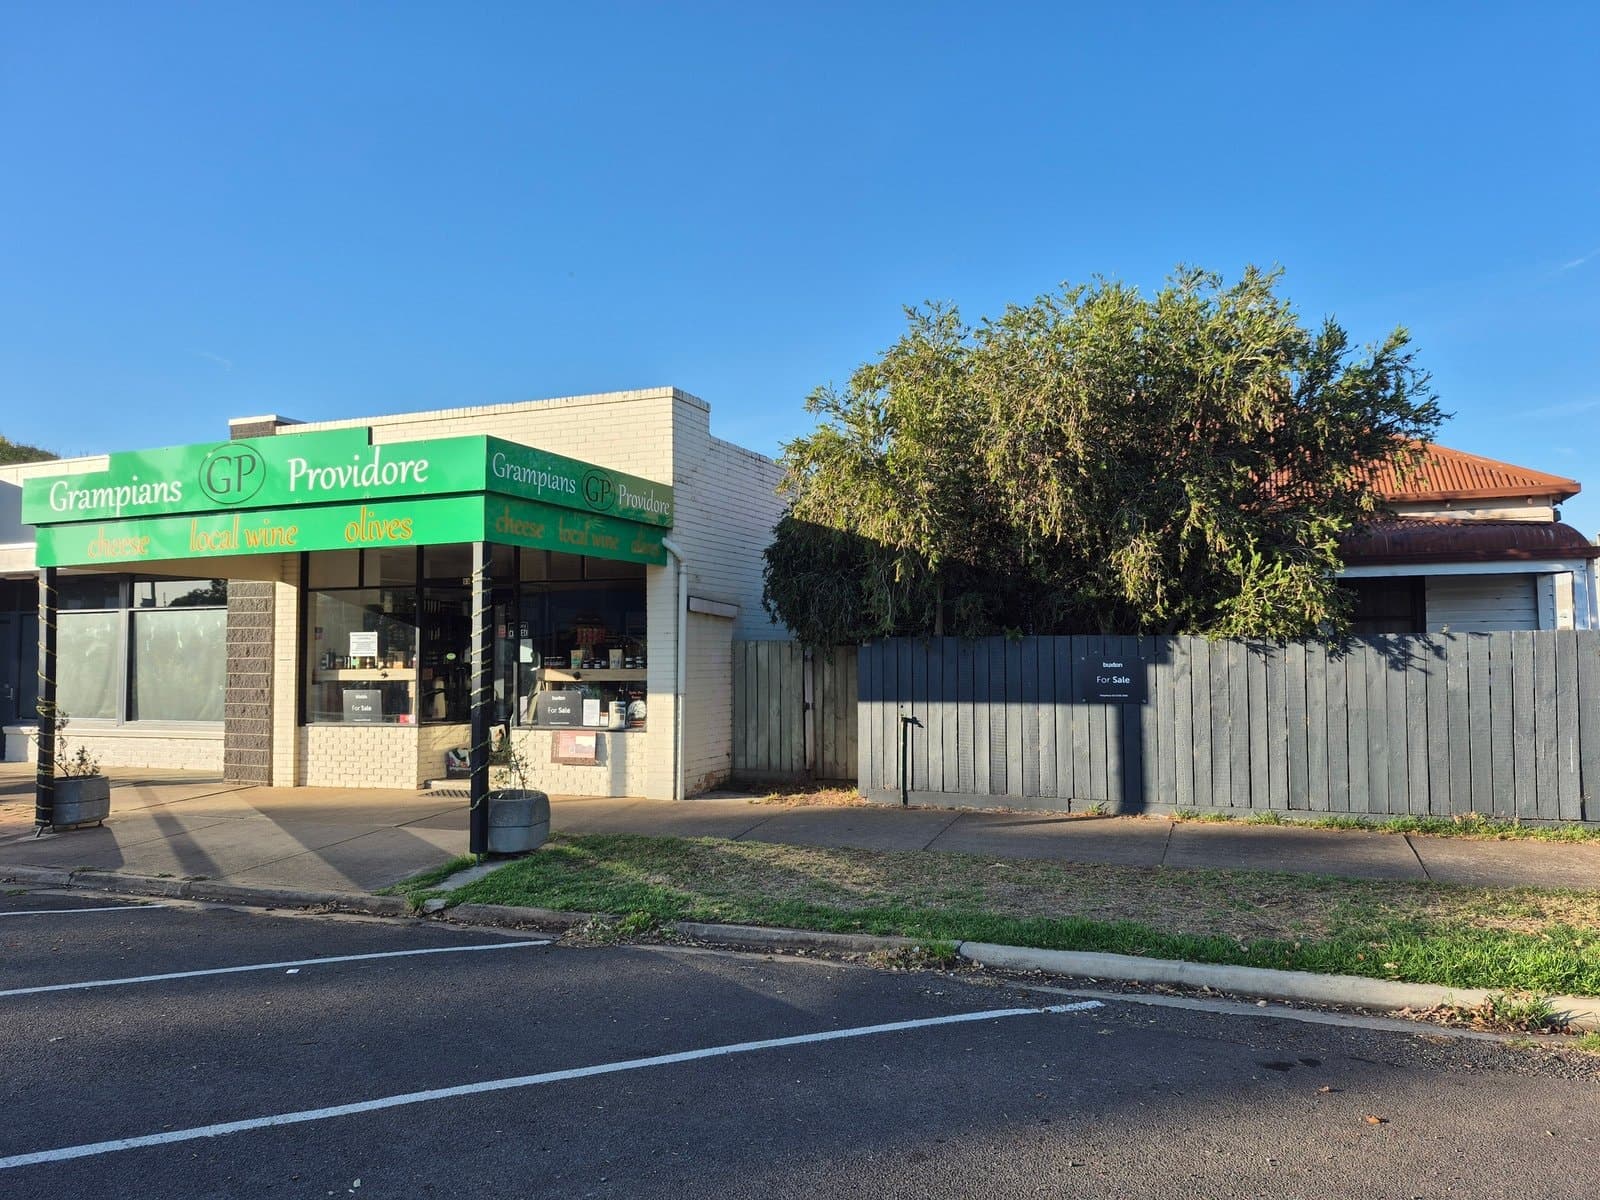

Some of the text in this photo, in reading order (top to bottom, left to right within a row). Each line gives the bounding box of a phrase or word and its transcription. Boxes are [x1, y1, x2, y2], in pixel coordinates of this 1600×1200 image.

[49, 446, 429, 518] Grampians GP Providore
[492, 452, 670, 515] Grampians GP Providore
[87, 504, 413, 559] cheese local wine olives
[495, 504, 545, 539] cheese
[558, 516, 591, 546] local
[1096, 675, 1131, 684] For Sale
